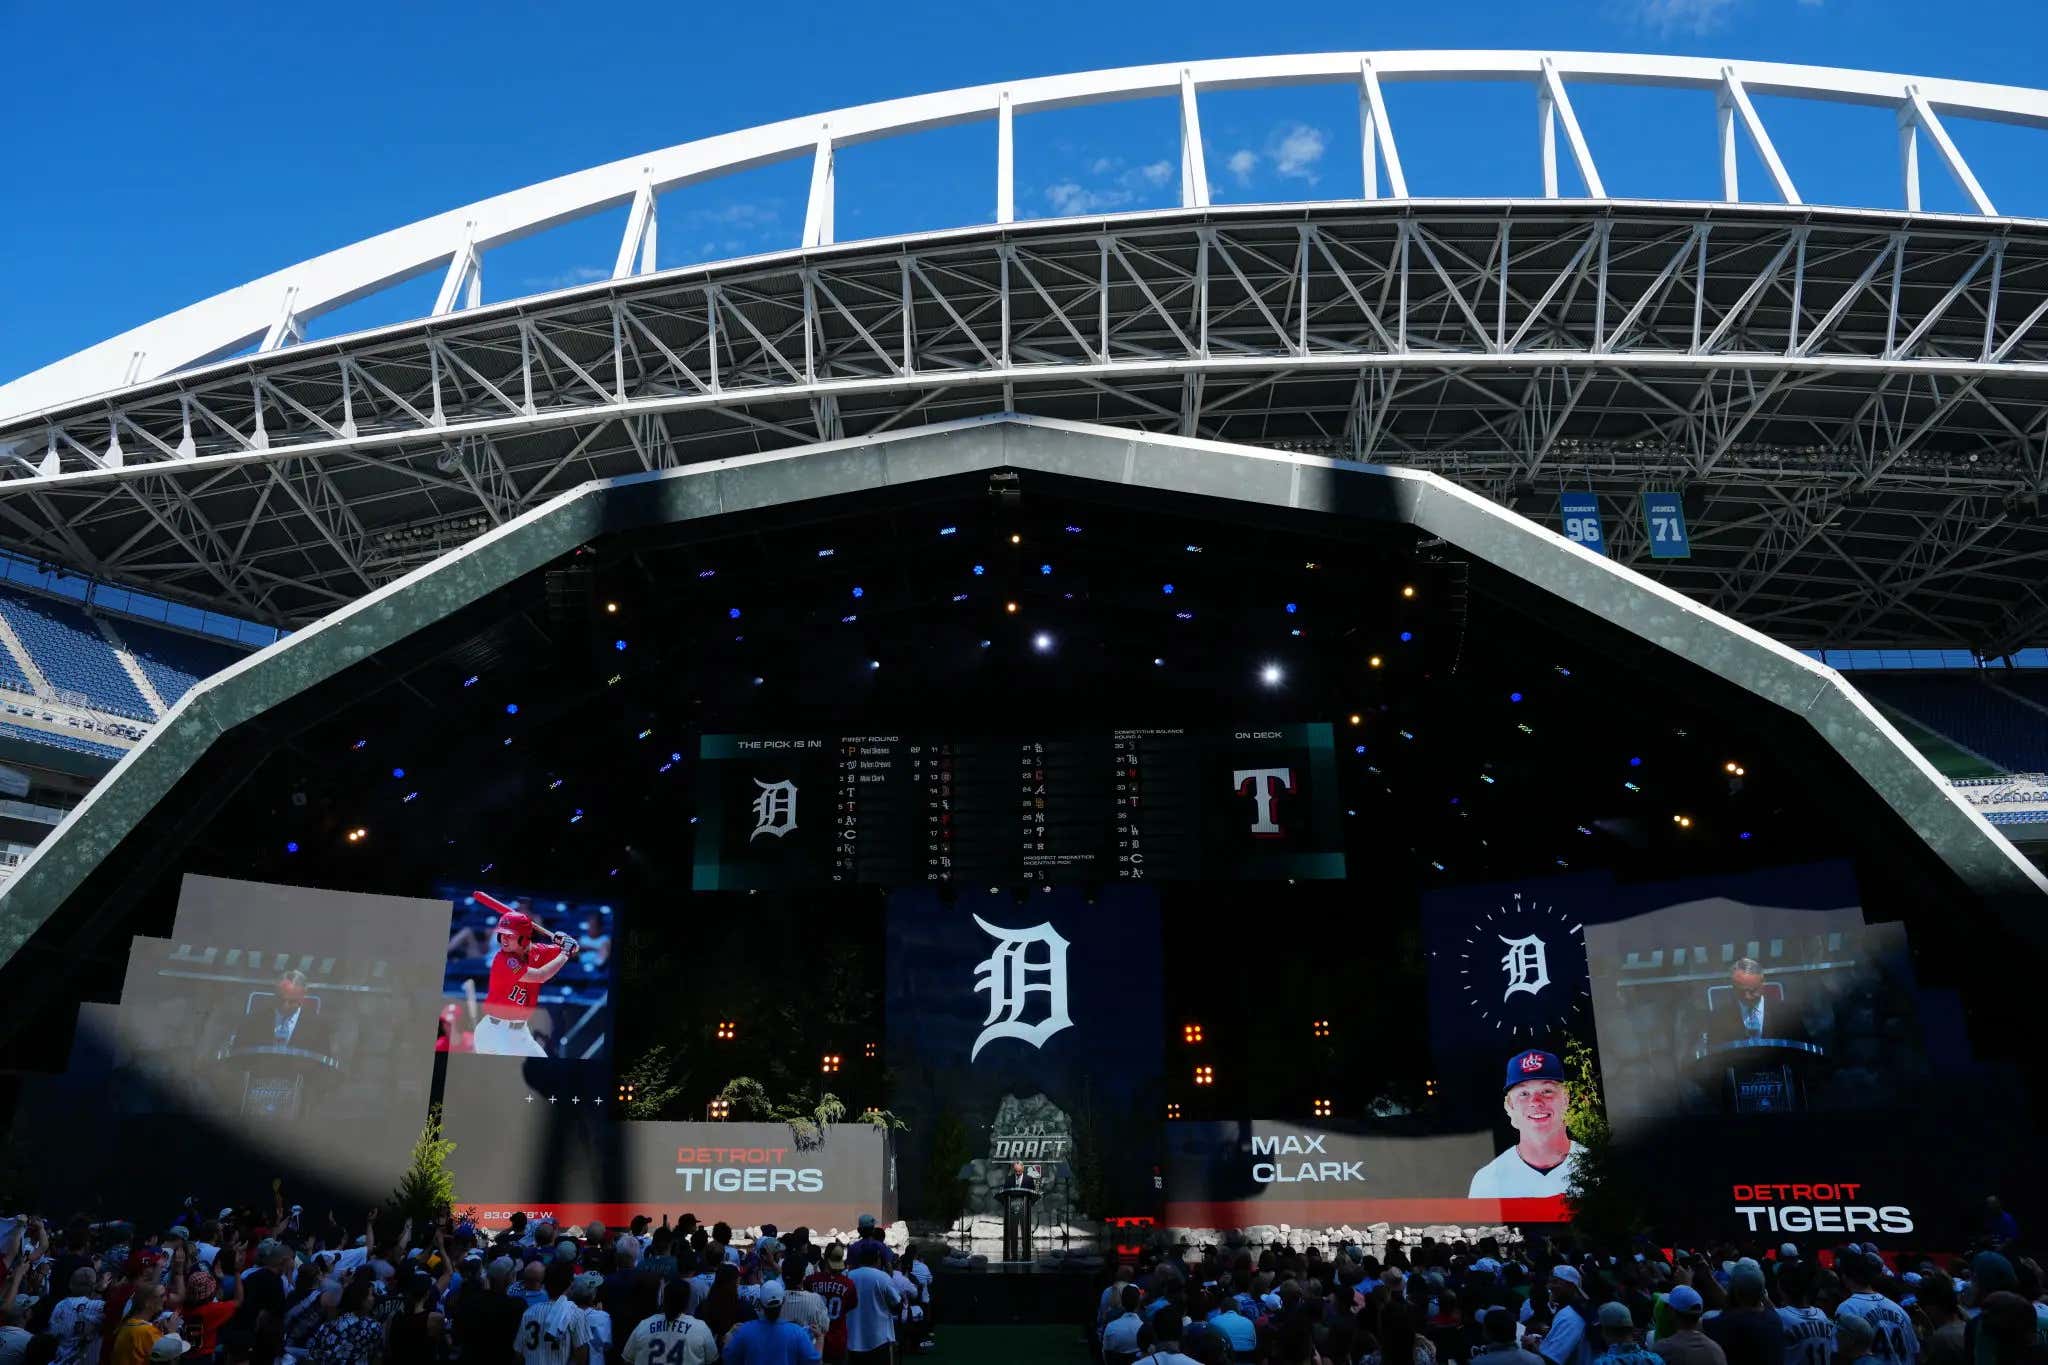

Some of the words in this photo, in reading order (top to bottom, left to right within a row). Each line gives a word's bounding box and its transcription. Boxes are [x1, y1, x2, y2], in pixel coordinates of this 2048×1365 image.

[1566, 518, 1600, 541] 96
[1652, 518, 1682, 541] 71
[738, 741, 761, 749] THE
[1253, 731, 1282, 739] DECK
[1233, 767, 1296, 838] T
[1498, 934, 1551, 1003] D
[508, 985, 527, 1005] 17
[971, 913, 1075, 1063] D
[677, 1147, 787, 1163] DETROIT
[993, 1141, 1067, 1159] DRAFT
[1251, 1135, 1327, 1155] MAX
[675, 1168, 823, 1192] TIGERS
[1252, 1161, 1365, 1182] CLARK
[1733, 1183, 1861, 1200] DETROIT
[1735, 1206, 1914, 1233] TIGERS
[812, 1281, 848, 1296] GRIFFEY
[649, 1319, 692, 1334] GRIFFEY
[648, 1339, 685, 1365] 24
